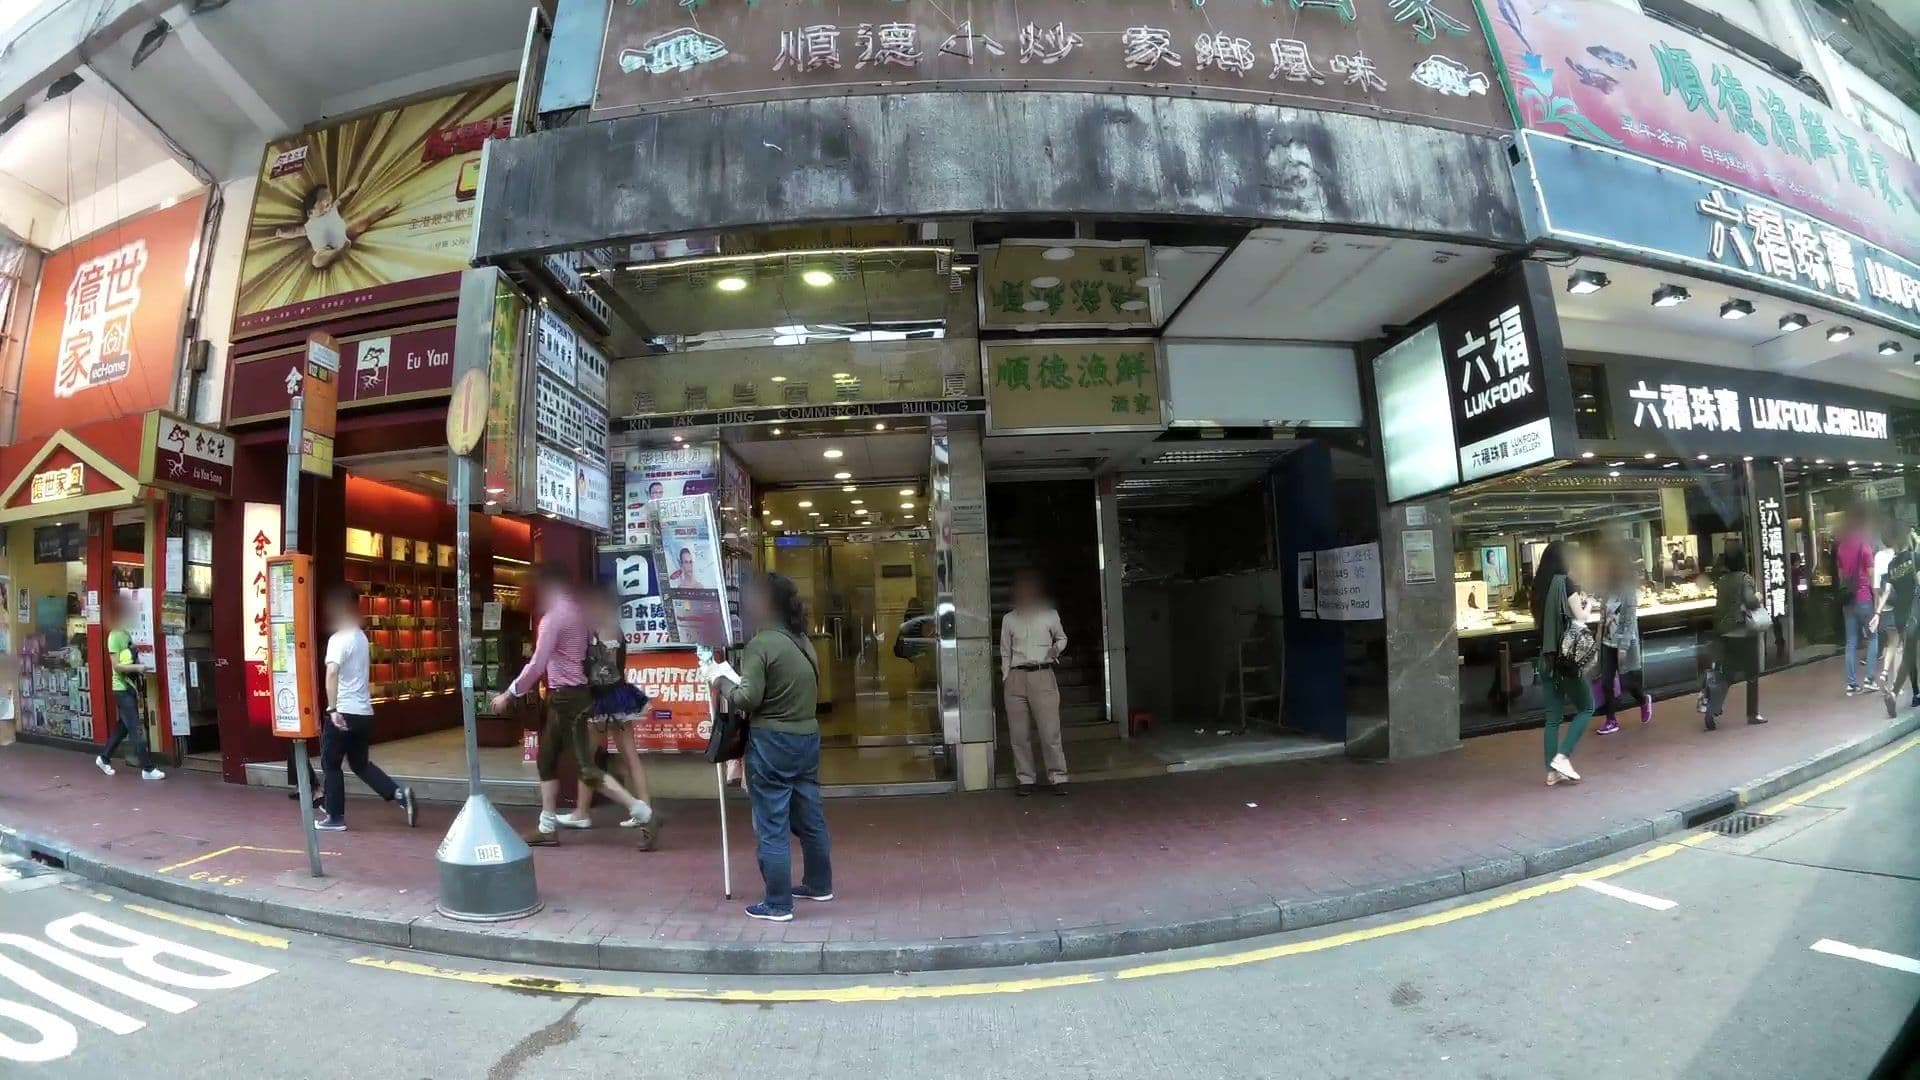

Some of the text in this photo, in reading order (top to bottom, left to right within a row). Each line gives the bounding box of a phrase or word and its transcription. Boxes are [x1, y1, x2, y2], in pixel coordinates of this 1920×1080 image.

[773, 21, 1387, 92] 順德小炒 家鄉風味
[1696, 189, 1861, 299] 六福珠寶
[407, 350, 449, 371] Eu Yan
[996, 351, 1151, 392] 順德漁鮮
[1456, 304, 1530, 393] 六福
[629, 400, 969, 432] KIN TAK FUNG COMMERCIAL BUILDING
[1464, 371, 1534, 419] LUKFOOK
[1629, 380, 1889, 440] 六福珠寶 LUKFOOK JEWELLERY
[1511, 430, 1541, 449] LUKFOOK
[1765, 497, 1786, 618] 六福珠寶
